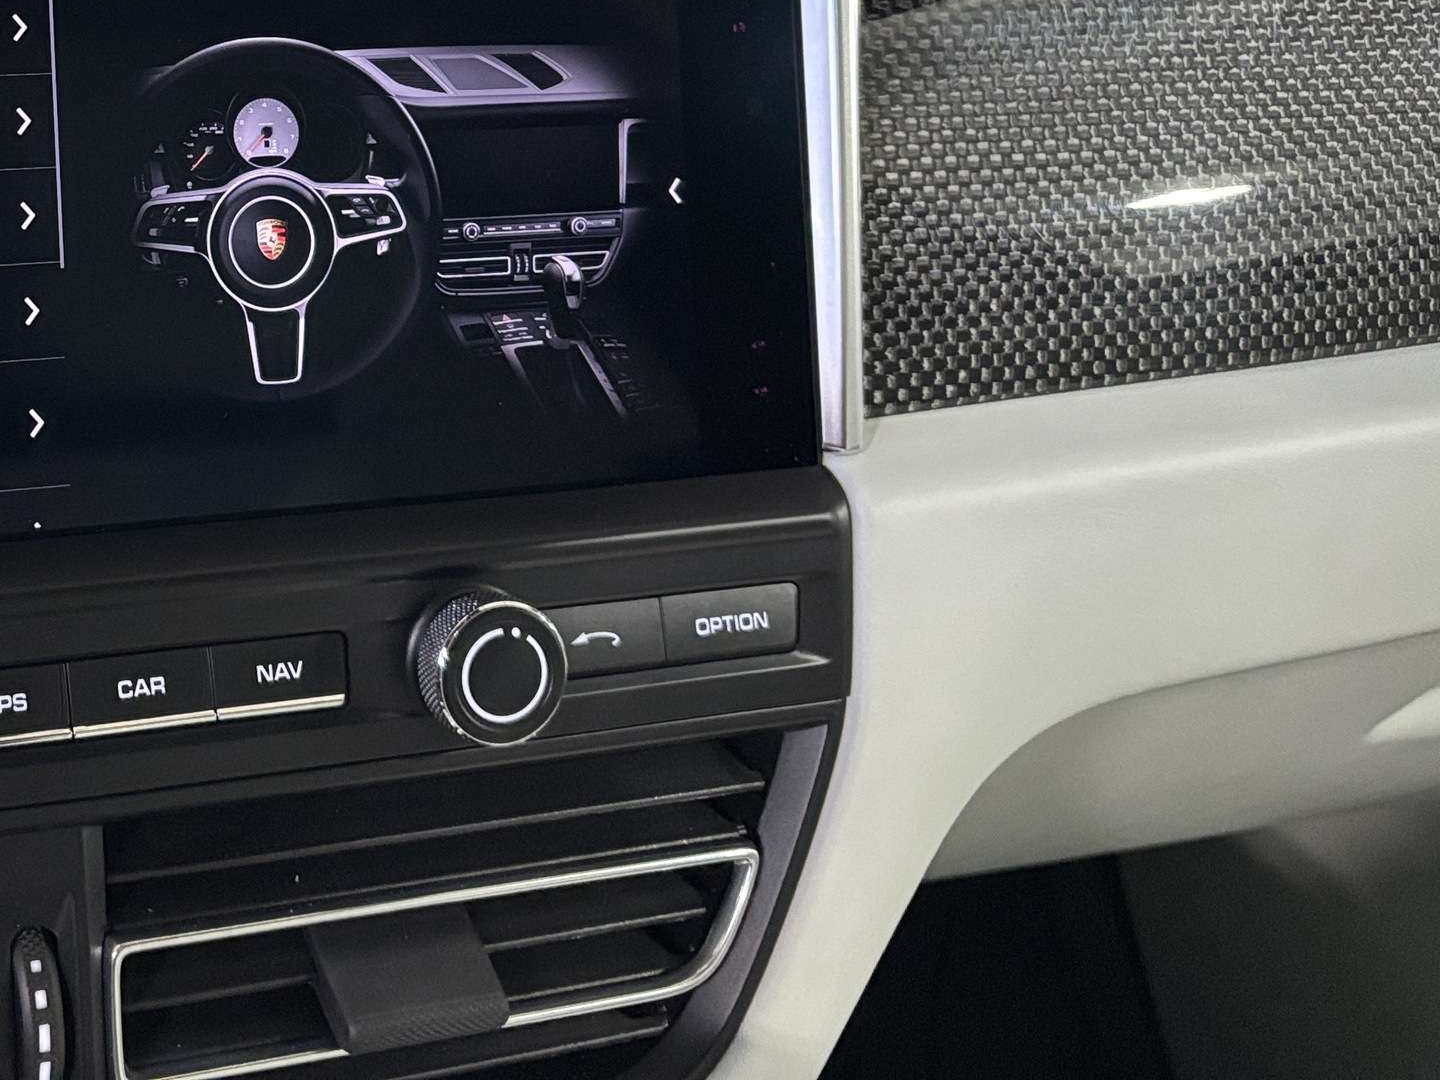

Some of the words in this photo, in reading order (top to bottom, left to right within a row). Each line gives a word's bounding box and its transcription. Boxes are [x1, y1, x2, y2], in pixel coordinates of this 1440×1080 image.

[696, 612, 768, 635] OPTION
[257, 661, 302, 682] NAV
[118, 676, 165, 698] CAR
